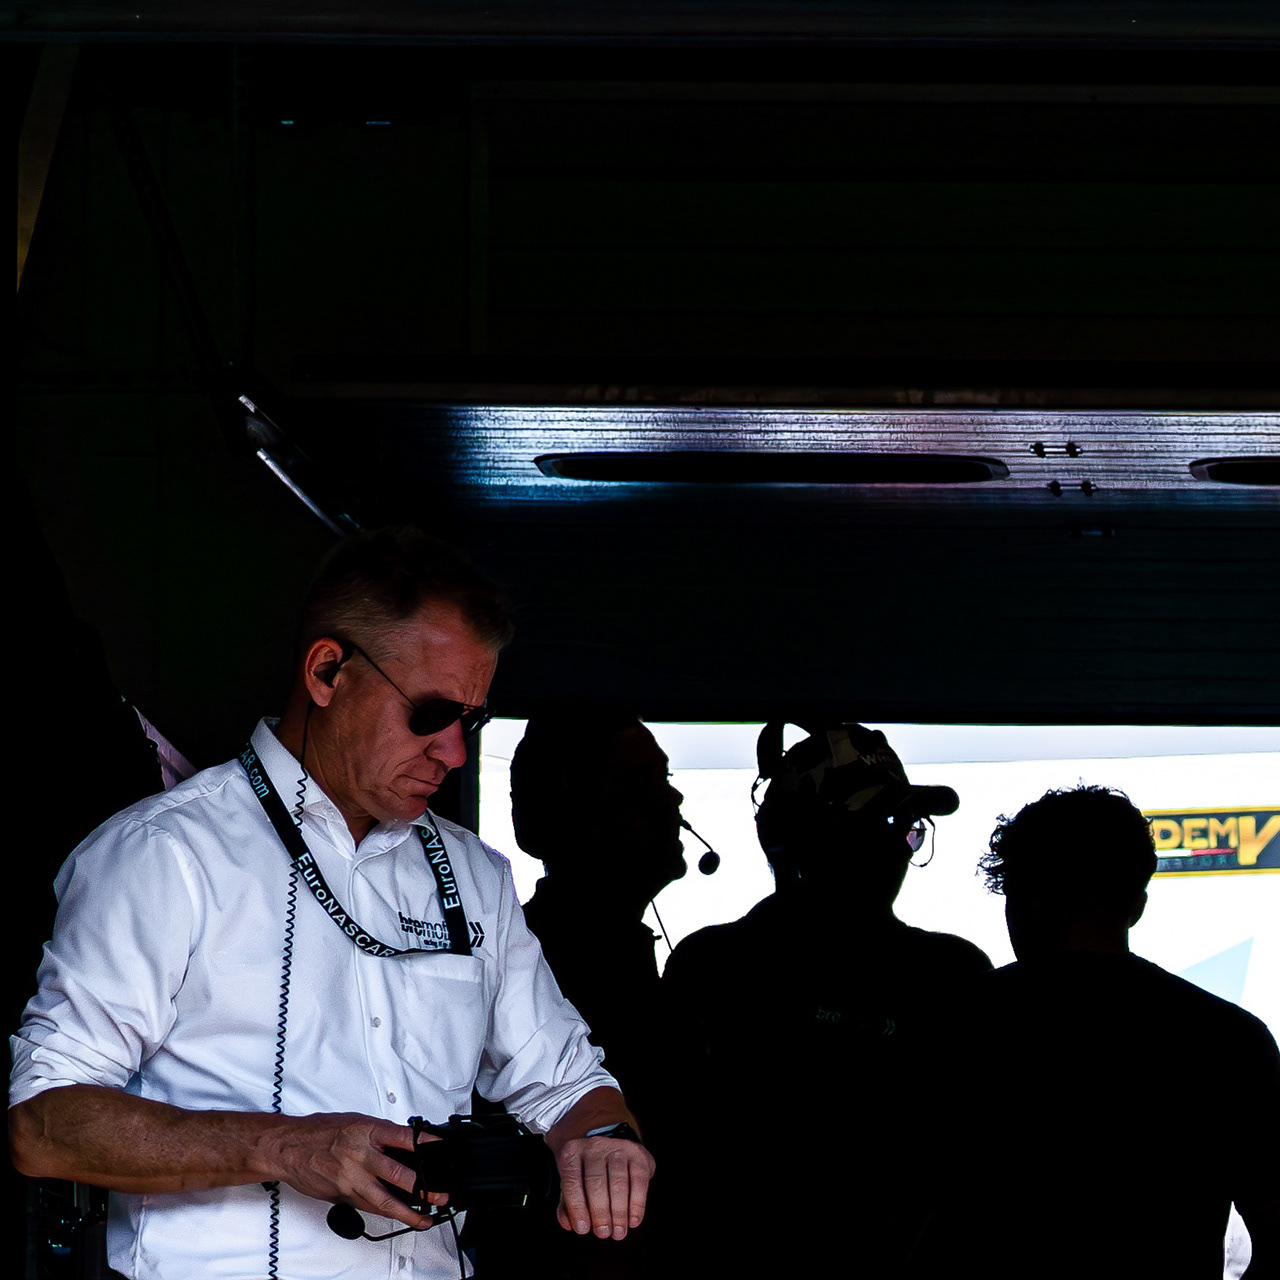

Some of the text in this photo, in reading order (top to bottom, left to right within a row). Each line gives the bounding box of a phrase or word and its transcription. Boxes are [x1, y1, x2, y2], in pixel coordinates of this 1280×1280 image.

[240, 748, 270, 799] AR.com
[297, 851, 396, 958] EuroNASCAR
[420, 827, 462, 910] EuroNAS
